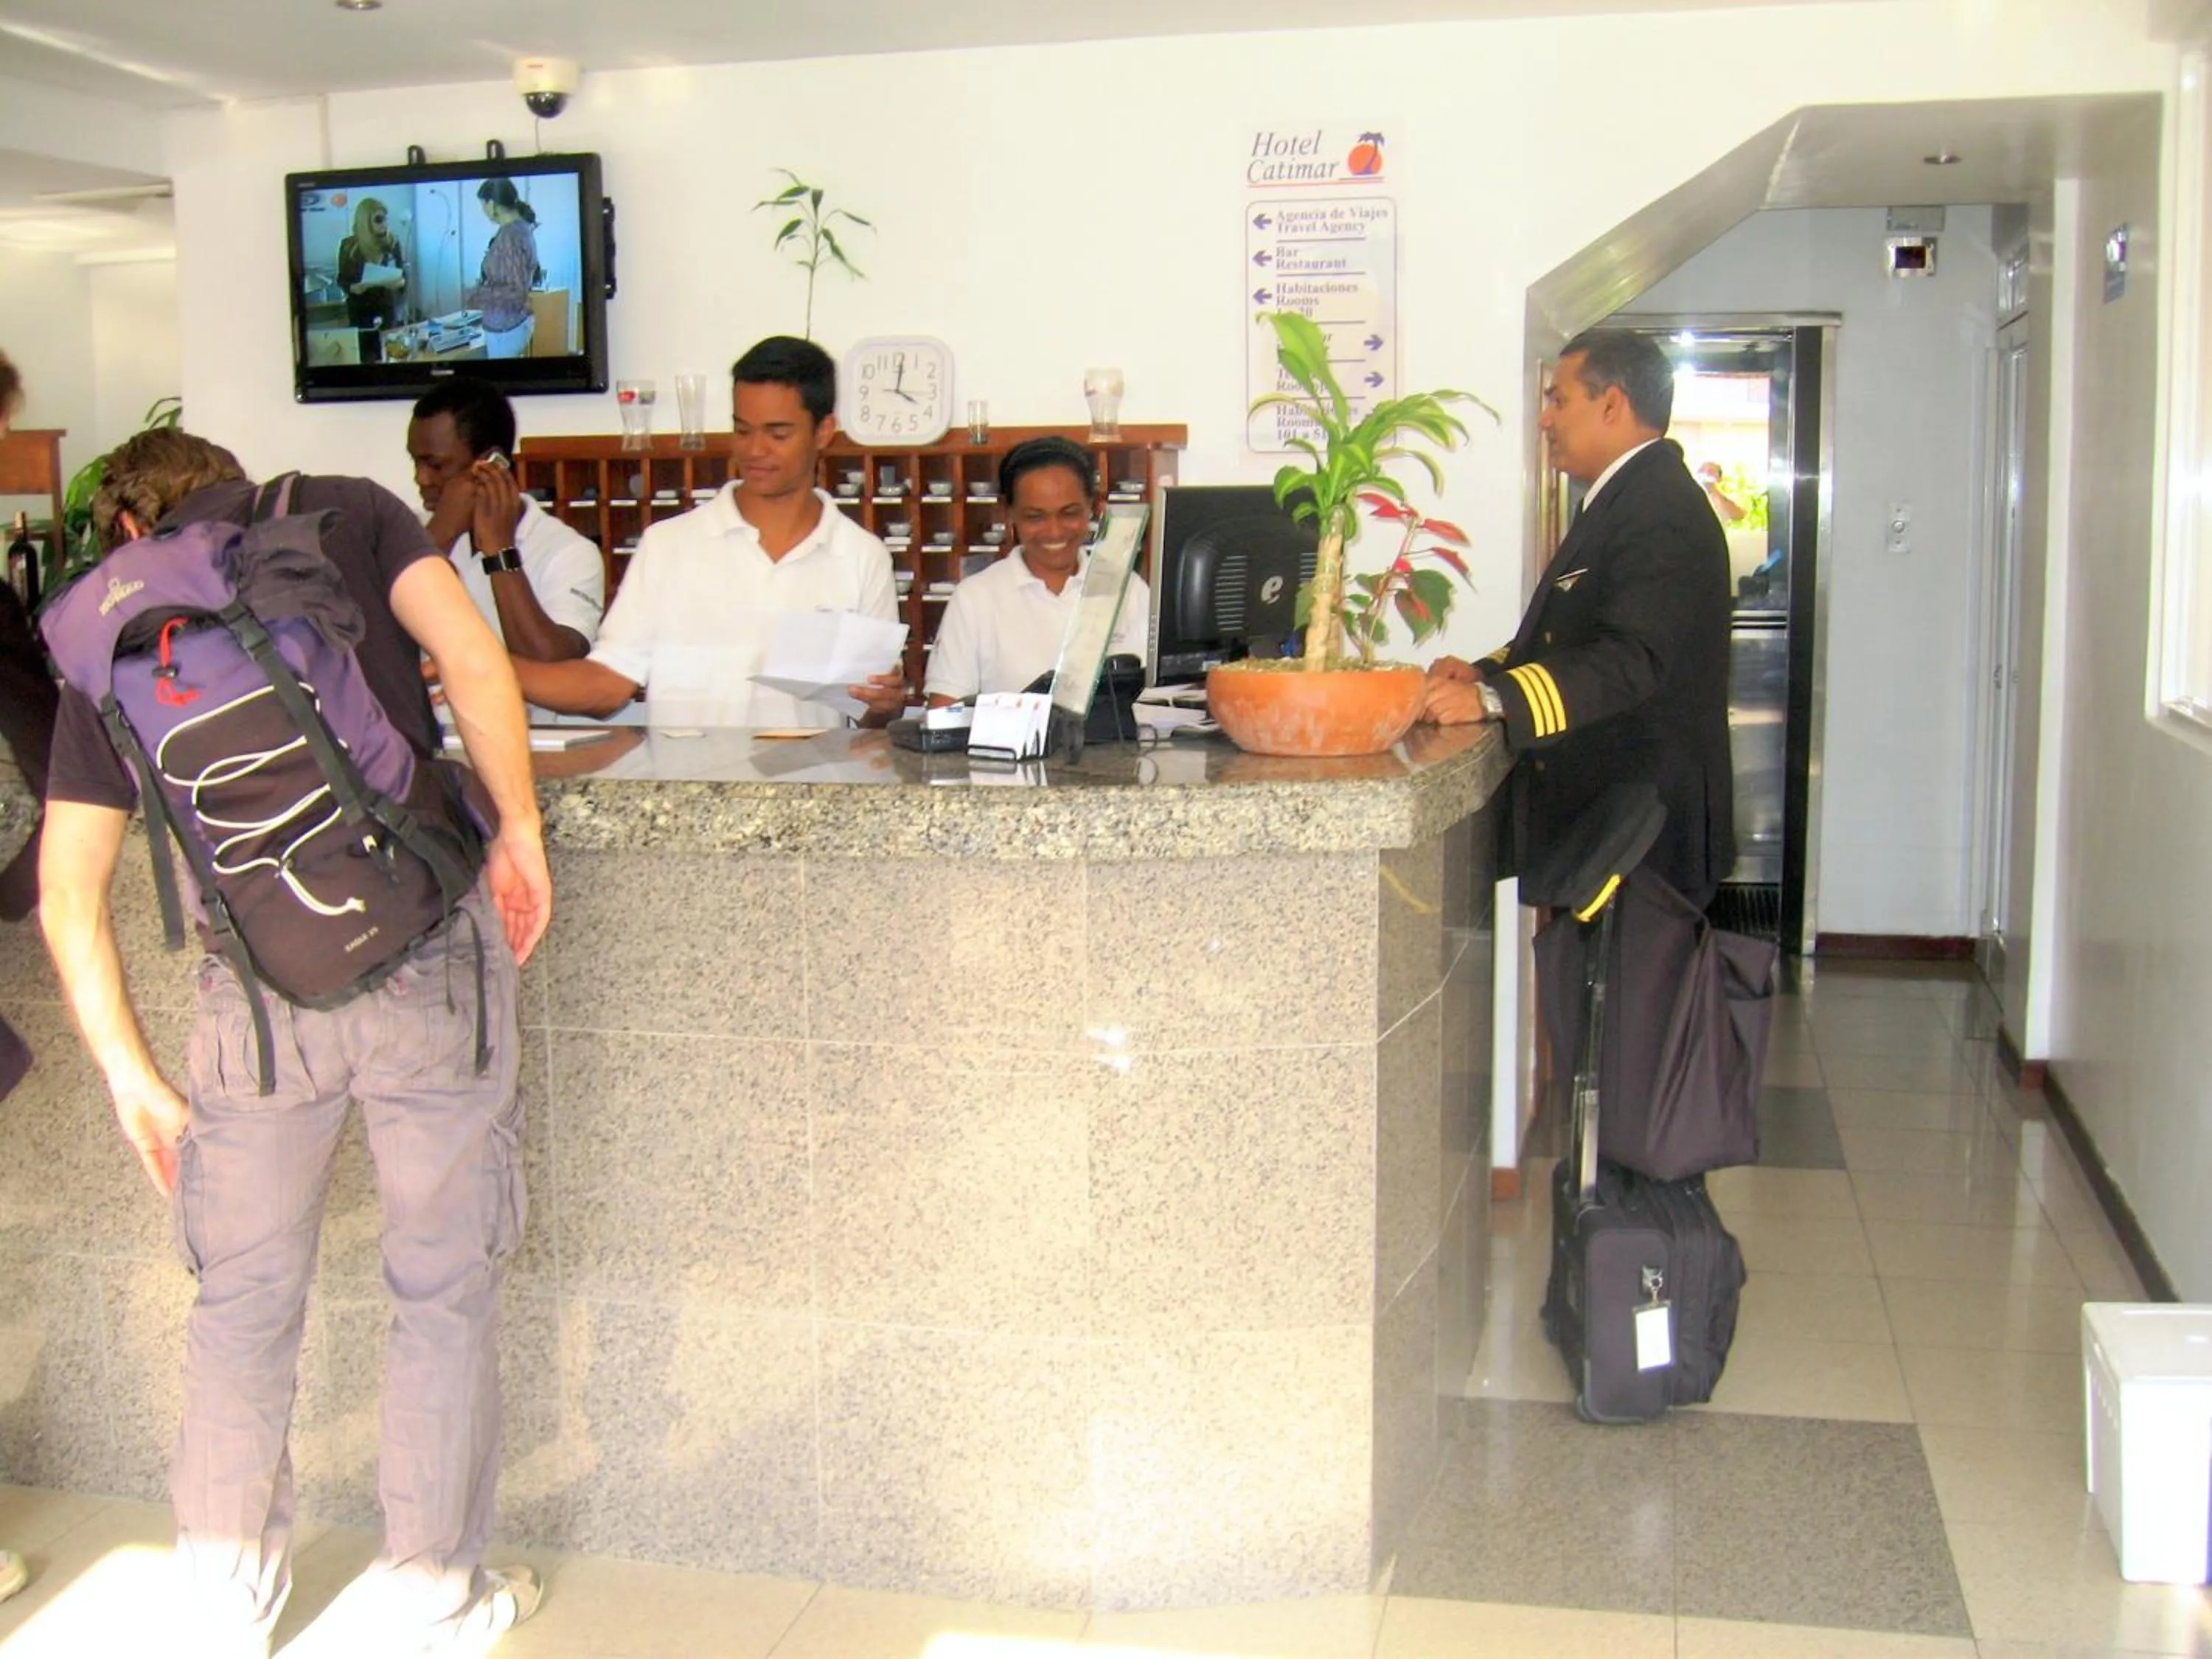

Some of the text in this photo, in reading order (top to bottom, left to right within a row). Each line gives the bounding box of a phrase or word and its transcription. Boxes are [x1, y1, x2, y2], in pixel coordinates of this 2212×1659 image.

[1251, 130, 1322, 157] Hotel
[1246, 157, 1340, 184] Catimar
[1276, 206, 1388, 222] Agencia de Viajes
[1276, 221, 1366, 234] Travel Agency
[1276, 246, 1298, 257] Bar
[1276, 258, 1346, 270] Restaurant
[1276, 282, 1359, 293] Habitaciones
[1276, 296, 1319, 305] Rooms
[927, 362, 937, 379] 2
[859, 385, 869, 402] 9
[929, 383, 937, 401] 3
[860, 406, 870, 422] 8
[923, 405, 933, 420] 4
[876, 414, 886, 431] 7
[891, 417, 902, 433] 6
[908, 414, 919, 431] 5
